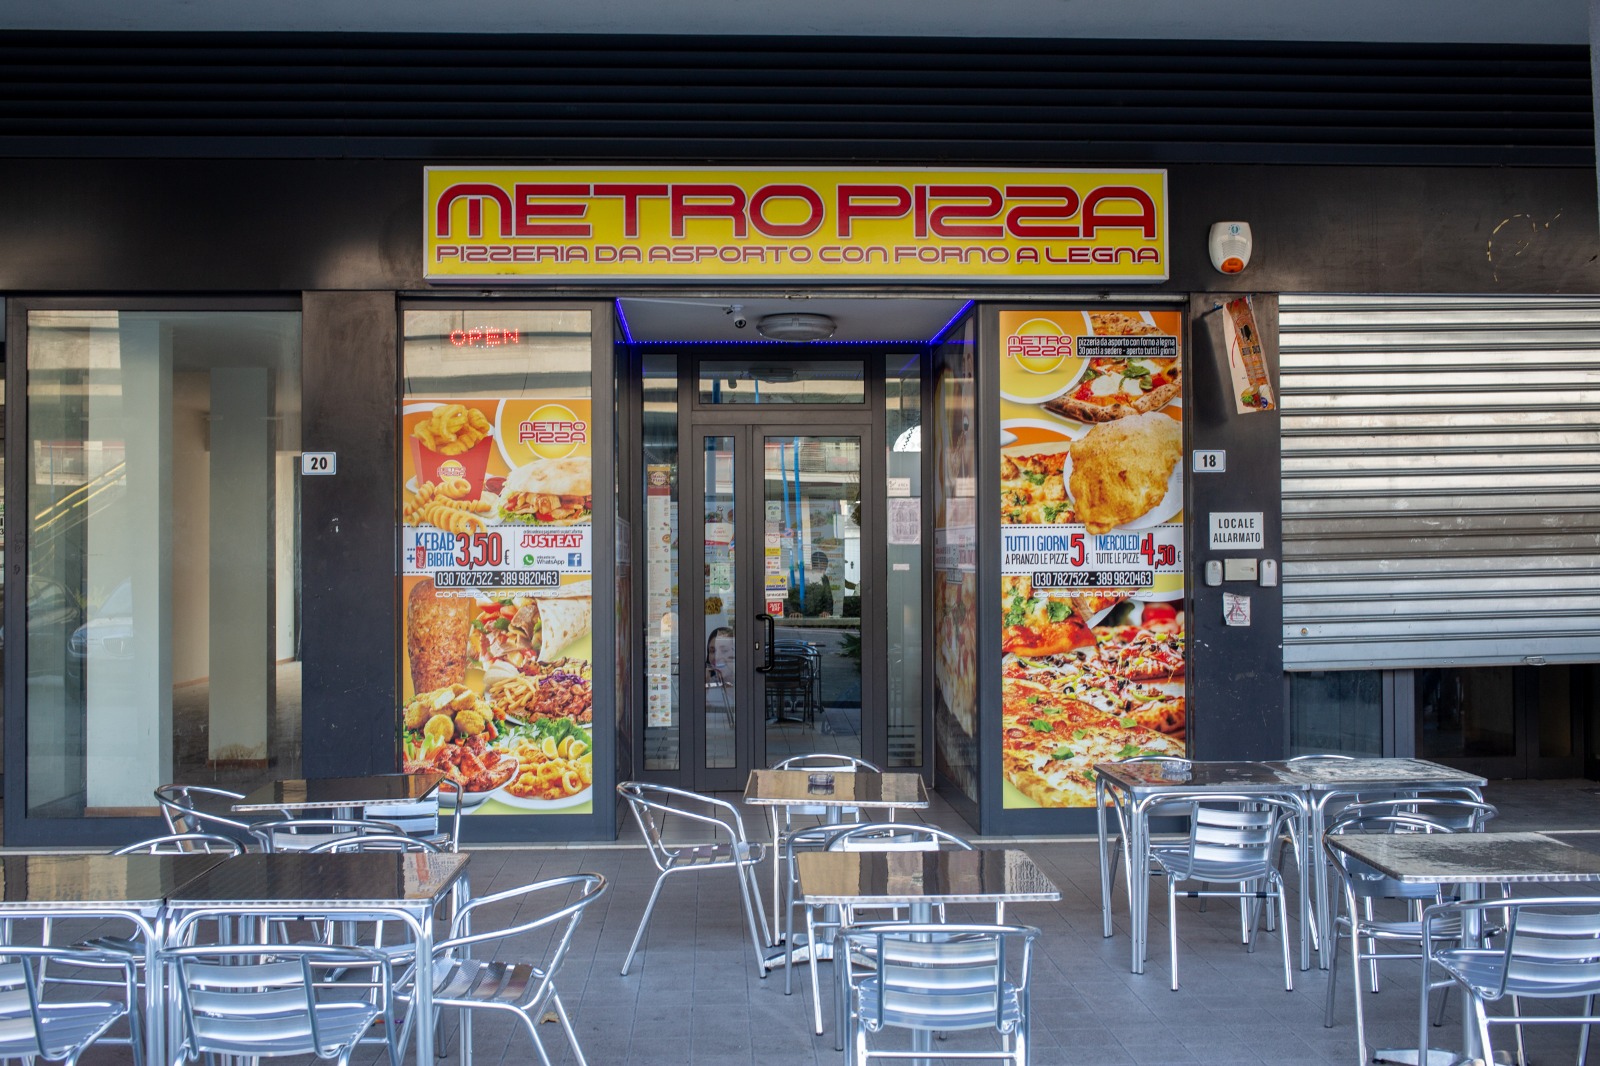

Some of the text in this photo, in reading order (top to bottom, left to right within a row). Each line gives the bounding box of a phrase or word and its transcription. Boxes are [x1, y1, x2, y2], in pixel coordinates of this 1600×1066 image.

[436, 183, 1156, 240] METRO PIZZA
[436, 246, 1160, 264] PIZZERIA DA ASPORTO CON FORNO A LEGNA
[450, 328, 519, 345] OPEN
[1007, 335, 1073, 345] METRO
[1079, 338, 1100, 347] pizzeria
[1100, 338, 1107, 346] da
[1108, 338, 1129, 347] asporto
[1140, 338, 1155, 346] forno
[1159, 338, 1175, 347] legna
[1007, 345, 1073, 357] PIZZA
[1086, 347, 1099, 355] posti
[1126, 347, 1143, 355] aperto
[519, 421, 587, 432] METRO
[519, 431, 587, 443] PIZZA
[310, 457, 328, 470] 20
[1202, 454, 1217, 468] 18
[1218, 518, 1255, 529] LOCALE
[415, 532, 455, 551] KEBAB
[520, 534, 583, 548] JUST EAT
[1005, 535, 1030, 552] TUTTI
[1037, 535, 1069, 552] GIORNI
[1099, 532, 1140, 551] MERCOLEDÌ
[1213, 532, 1261, 543] ALLARMATO
[455, 532, 503, 570] 3,50
[504, 549, 510, 566] €
[1070, 533, 1090, 567] 5 €
[1140, 533, 1182, 570] 4,50 €
[427, 552, 455, 567] BIBITA
[1005, 553, 1069, 565] A PRANZO LE PIZZE
[1096, 552, 1140, 564] TUTTE LE PIZZE
[437, 571, 454, 586] 030
[455, 571, 493, 586] 7827522
[500, 571, 518, 586] 389
[518, 571, 558, 586] 9820463
[1035, 571, 1052, 586] 030
[1052, 571, 1089, 586] 7827522
[1096, 571, 1113, 586] 389
[1113, 571, 1152, 586] 9820463
